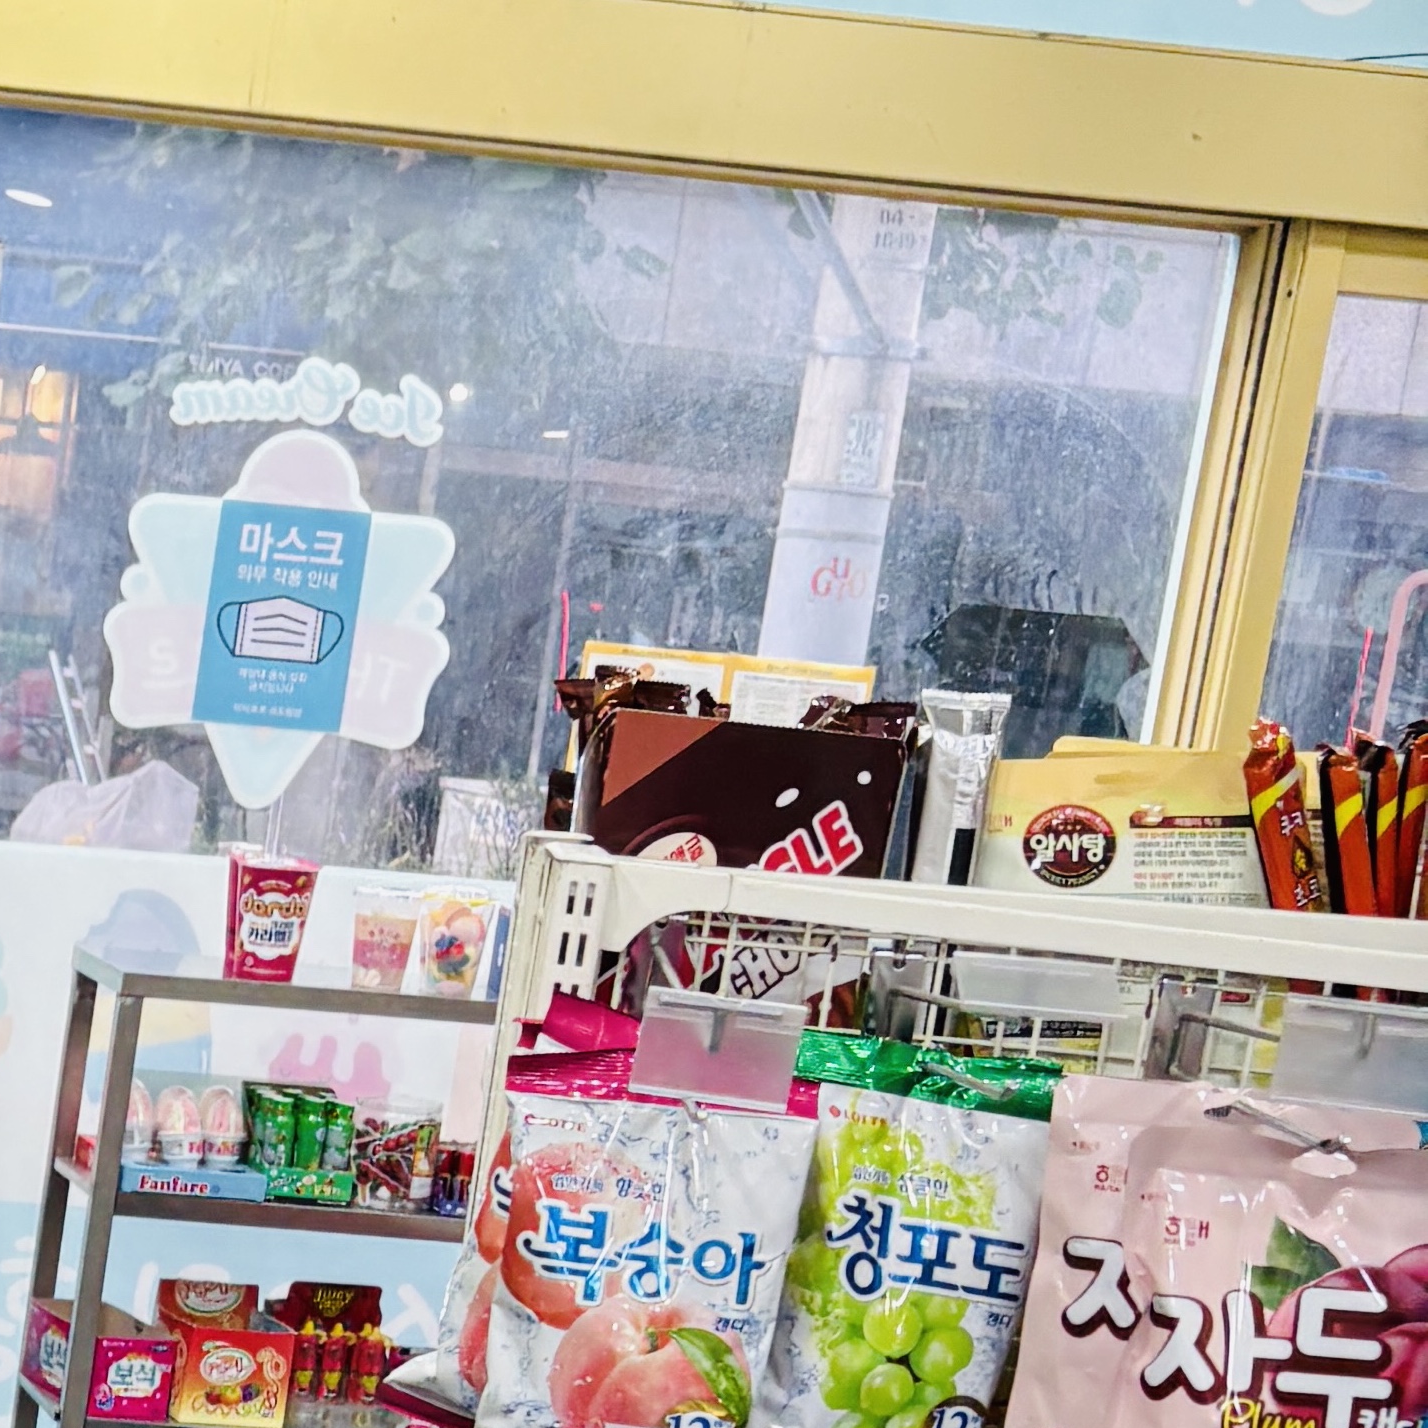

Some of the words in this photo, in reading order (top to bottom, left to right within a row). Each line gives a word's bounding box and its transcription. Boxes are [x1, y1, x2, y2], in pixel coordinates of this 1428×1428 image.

[240, 522, 344, 566] 마스크
[307, 570, 339, 591] 안내
[1027, 828, 1109, 870] 알사탕
[140, 1174, 208, 1196] Fanfare
[518, 1198, 765, 1306] 복숭아
[826, 1193, 1036, 1303] 청포도
